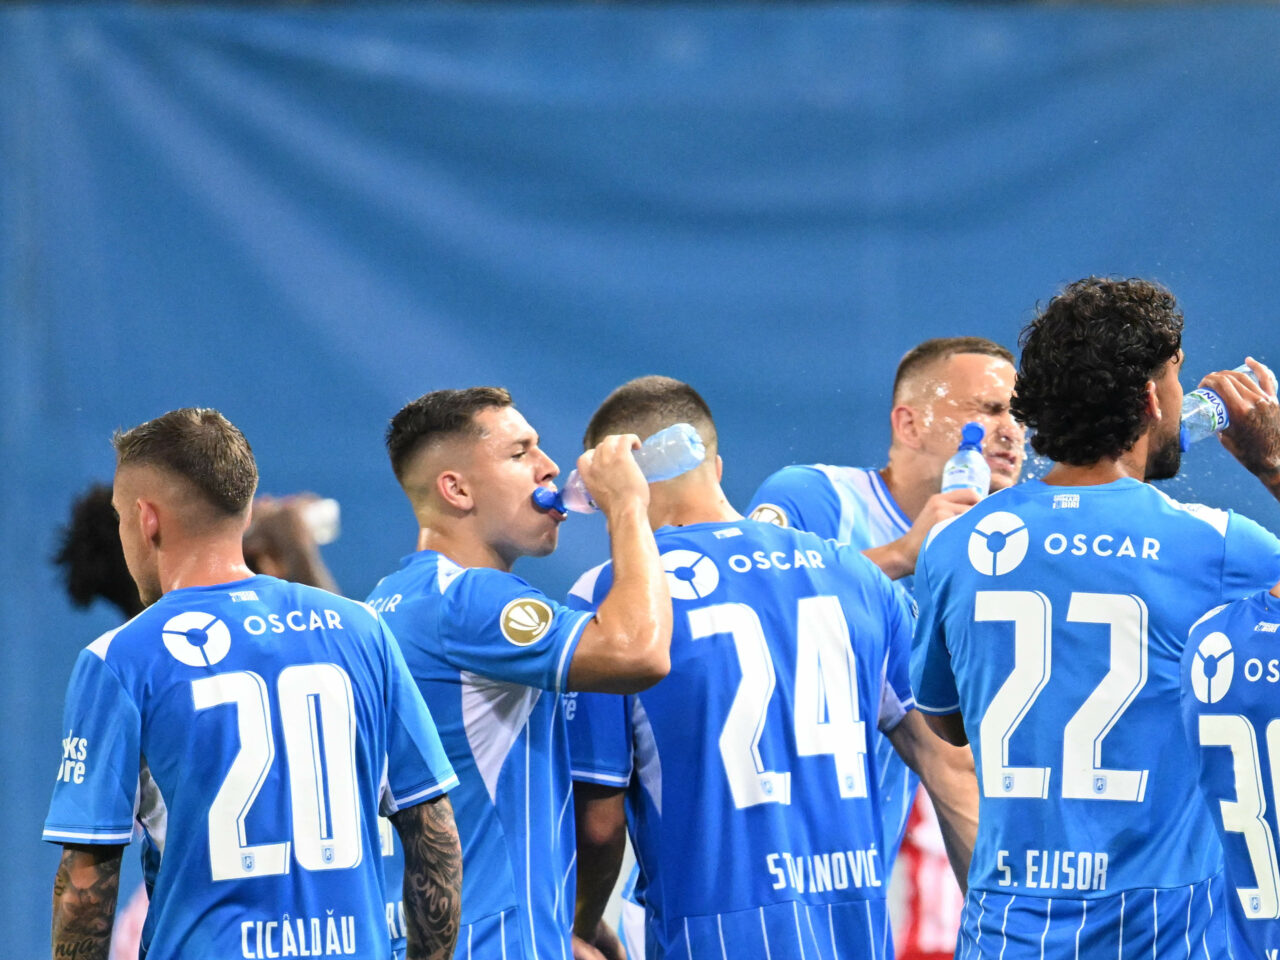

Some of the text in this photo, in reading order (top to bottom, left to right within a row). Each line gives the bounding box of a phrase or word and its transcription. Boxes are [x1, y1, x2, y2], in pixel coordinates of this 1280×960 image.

[1203, 392, 1224, 425] DEVIN
[728, 549, 826, 573] OSCAR
[1044, 533, 1161, 560] OSCAR
[243, 609, 343, 635] OSCAR
[689, 596, 867, 809] 24
[974, 590, 1149, 802] 22
[192, 663, 358, 882] 20
[997, 849, 1109, 890] S. ELISOR
